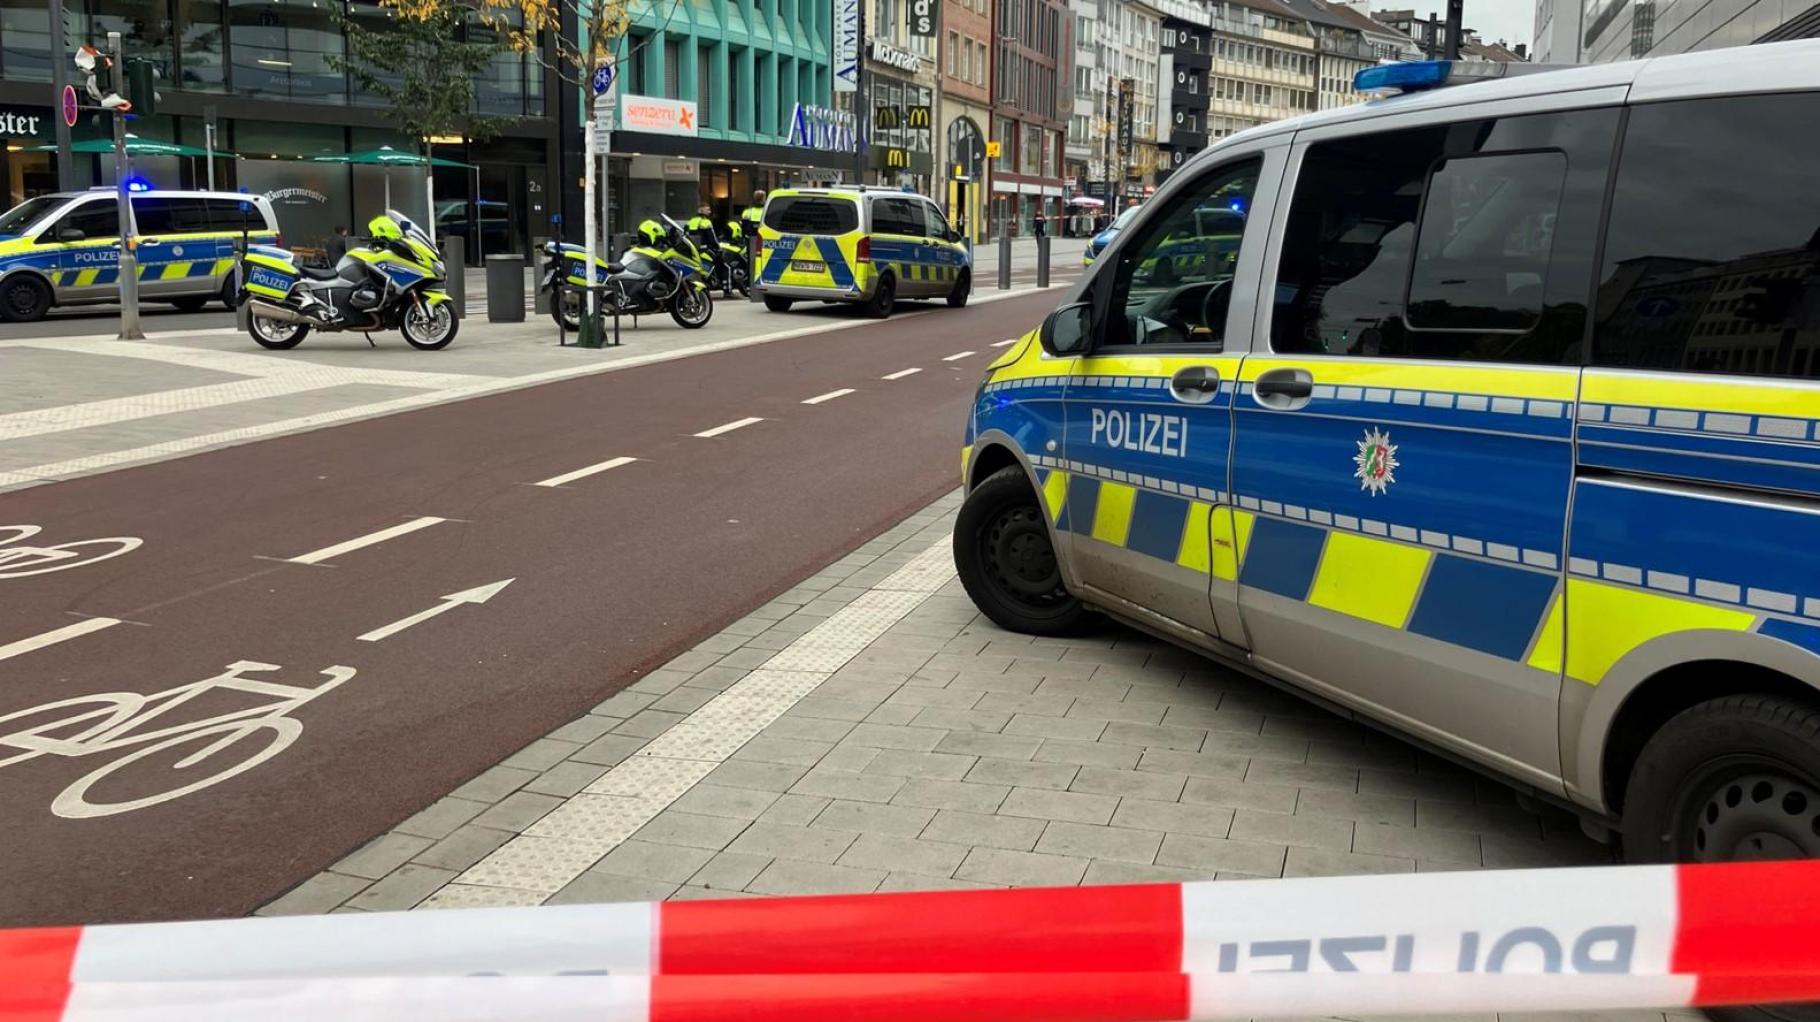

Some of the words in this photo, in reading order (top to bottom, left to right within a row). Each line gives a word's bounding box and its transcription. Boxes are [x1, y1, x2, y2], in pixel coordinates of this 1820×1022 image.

[762, 240, 796, 250] POLIZEI
[253, 272, 289, 290] POLIZEI
[1091, 408, 1188, 457] POLIZEI
